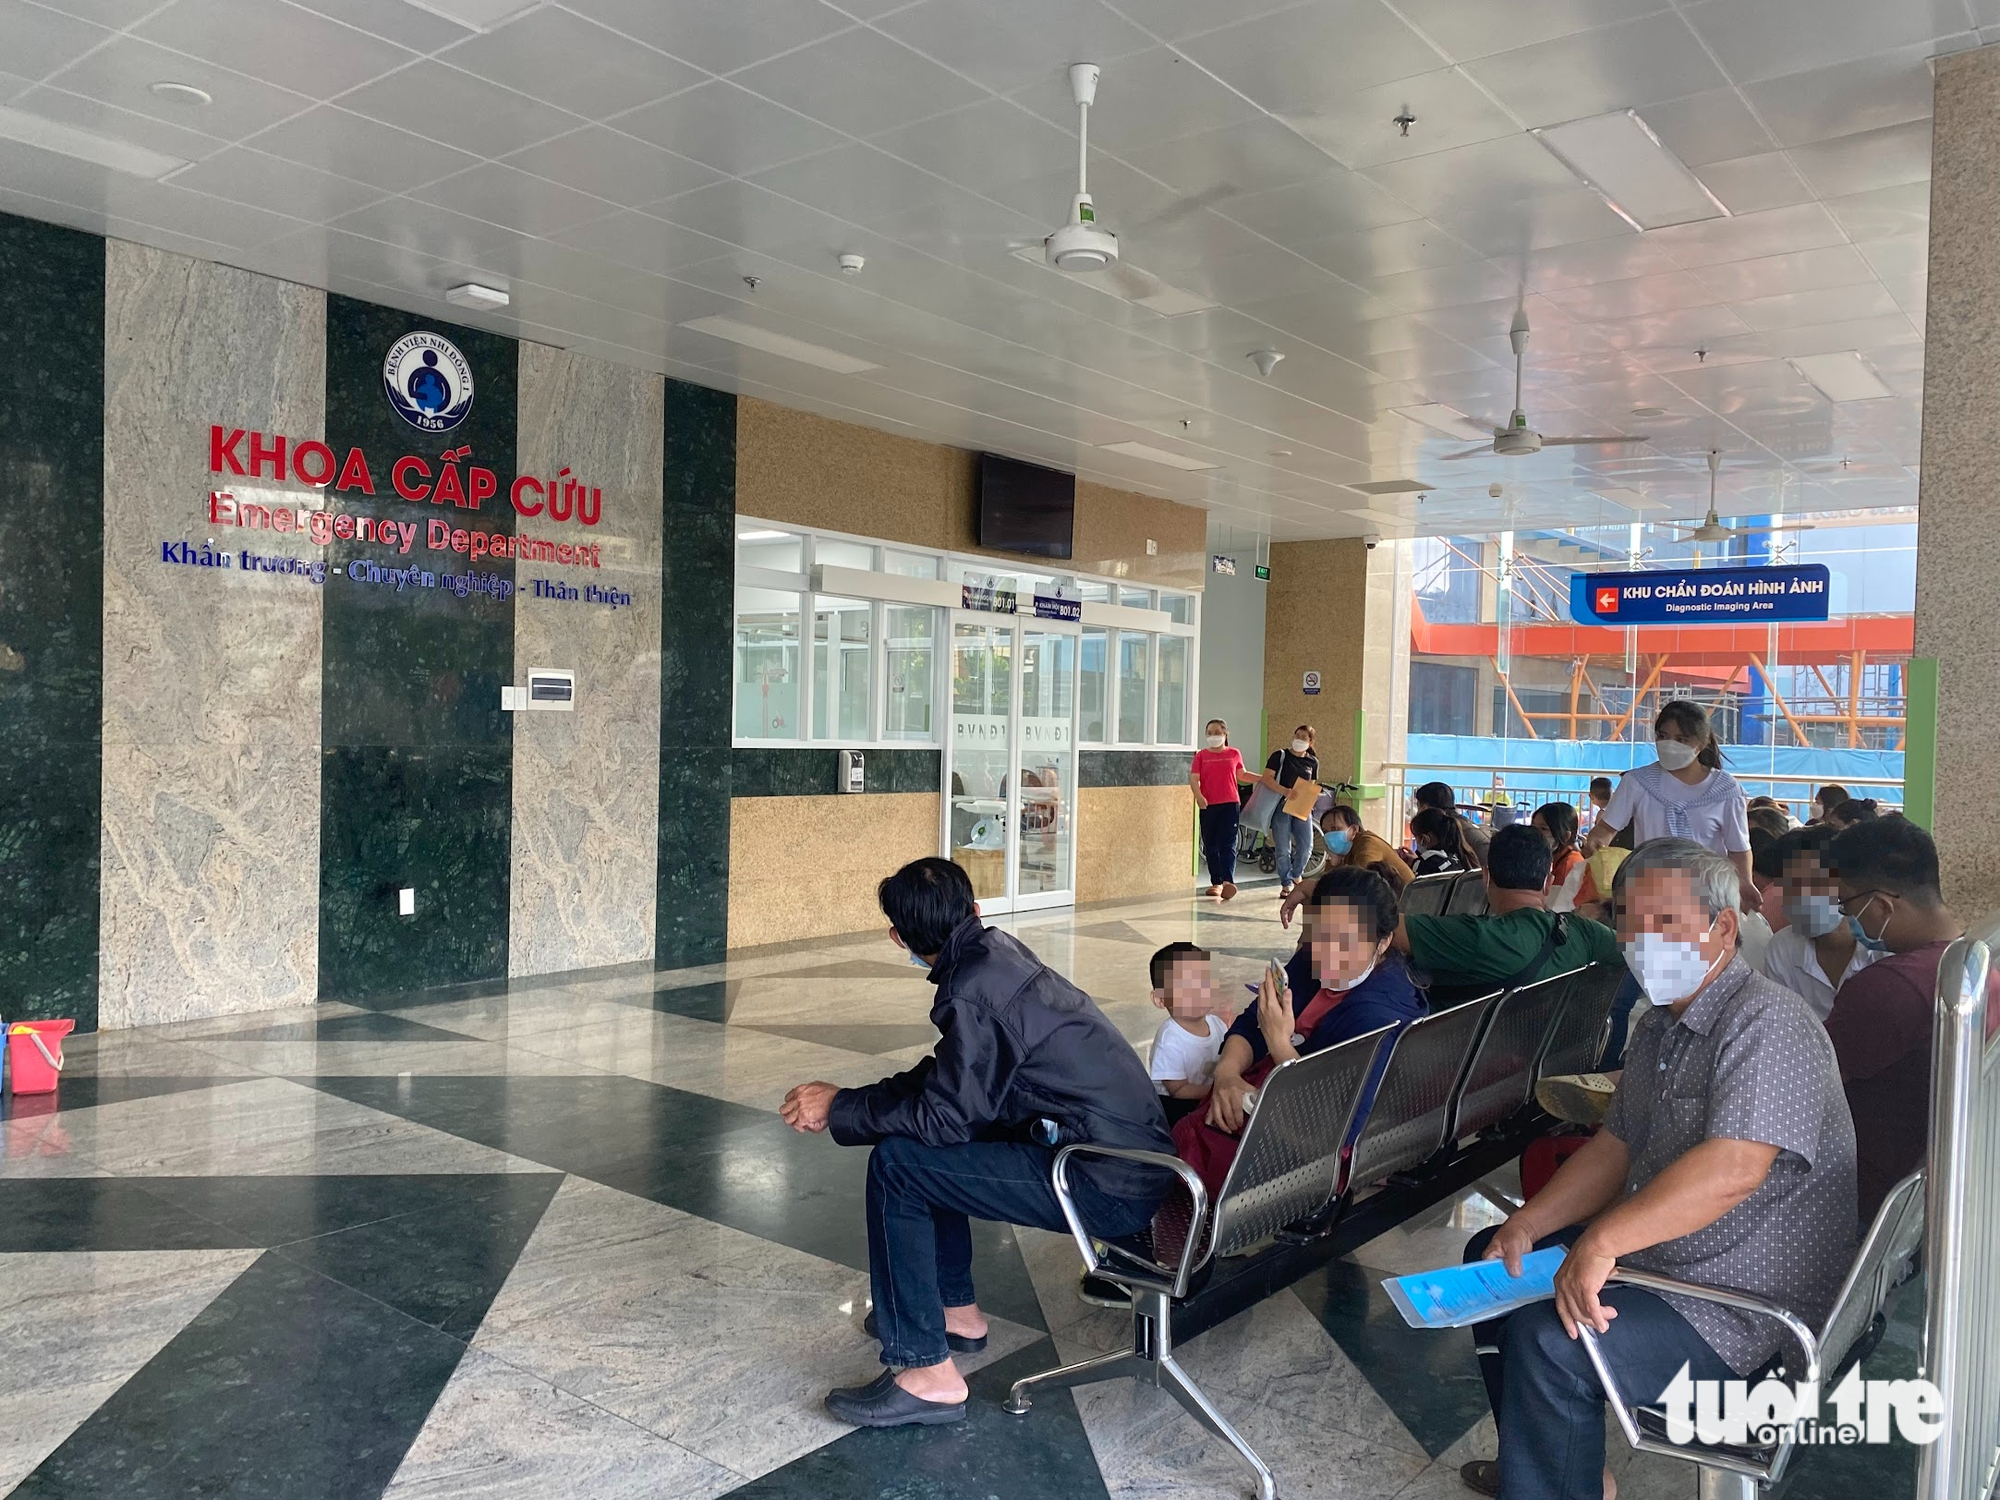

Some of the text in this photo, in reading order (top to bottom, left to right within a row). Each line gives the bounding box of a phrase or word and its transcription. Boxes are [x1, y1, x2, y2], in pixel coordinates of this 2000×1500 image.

[388, 346, 404, 376] BỆNH
[402, 335, 427, 348] VIỆN
[430, 338, 449, 353] NHI
[416, 415, 444, 429] 1956
[210, 424, 601, 525] KHOA CẤP CỨU
[208, 491, 601, 568] Emergency Department
[348, 559, 435, 592] Chuyên
[441, 570, 513, 601] nghiệp
[532, 579, 578, 600] Thân
[585, 585, 631, 610] thiện
[1623, 577, 1823, 599] KHU CHẨN ĐOÁN HÌNH ẢNH
[993, 596, 1015, 609] B01.01
[1060, 605, 1080, 618] B01.02
[1666, 602, 1774, 613] Diagnostic Imaging Area
